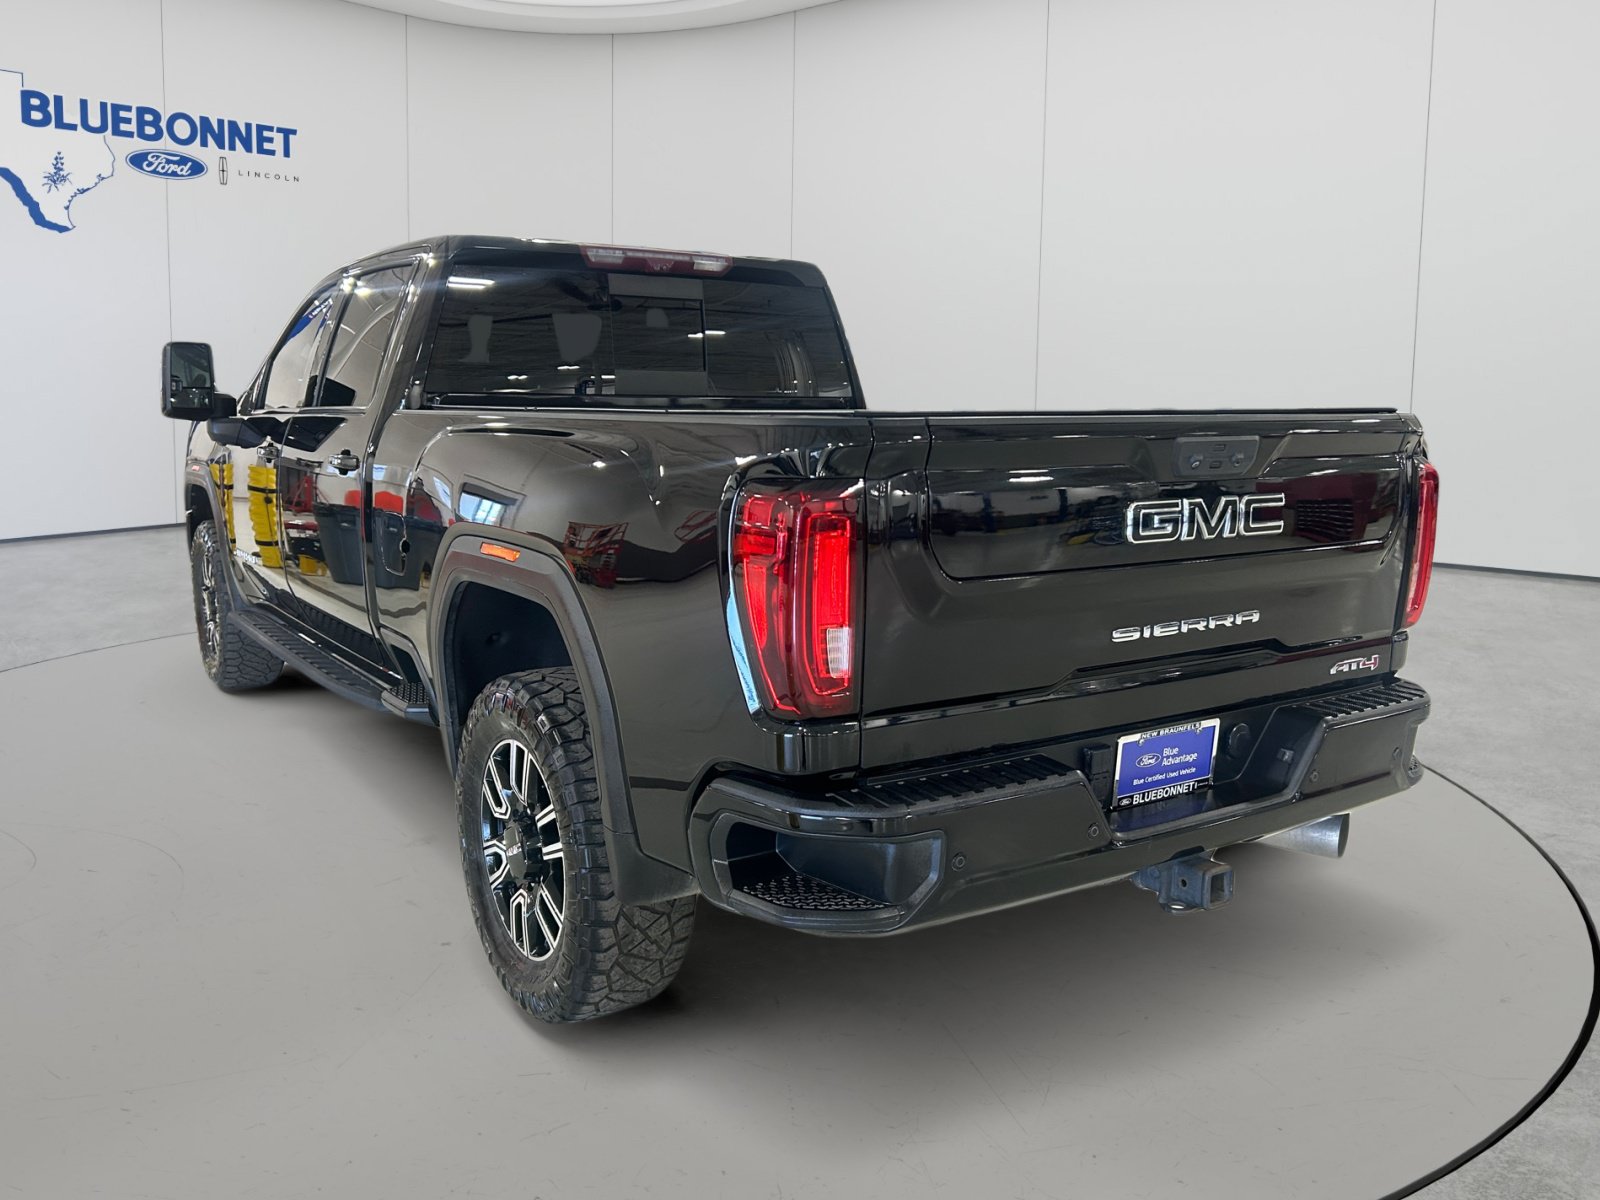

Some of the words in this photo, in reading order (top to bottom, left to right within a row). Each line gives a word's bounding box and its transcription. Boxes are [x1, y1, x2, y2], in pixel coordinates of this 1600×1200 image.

[20, 89, 298, 158] BLUEBONNET
[142, 152, 192, 176] Ford
[237, 169, 300, 183] LINCOLN
[1126, 492, 1285, 544] GMC
[1111, 609, 1260, 643] SIERRA
[1329, 654, 1379, 675] AT4
[1141, 731, 1158, 739] NEW
[1160, 723, 1200, 736] BRAUNFELS
[1139, 755, 1156, 767] Ford
[1161, 752, 1198, 767] Advantage
[1162, 747, 1179, 756] Blue
[1133, 777, 1145, 786] Blue
[1145, 773, 1166, 783] Certified
[1180, 767, 1197, 776] Vehicle
[1132, 782, 1195, 805] BLUEBONNET
